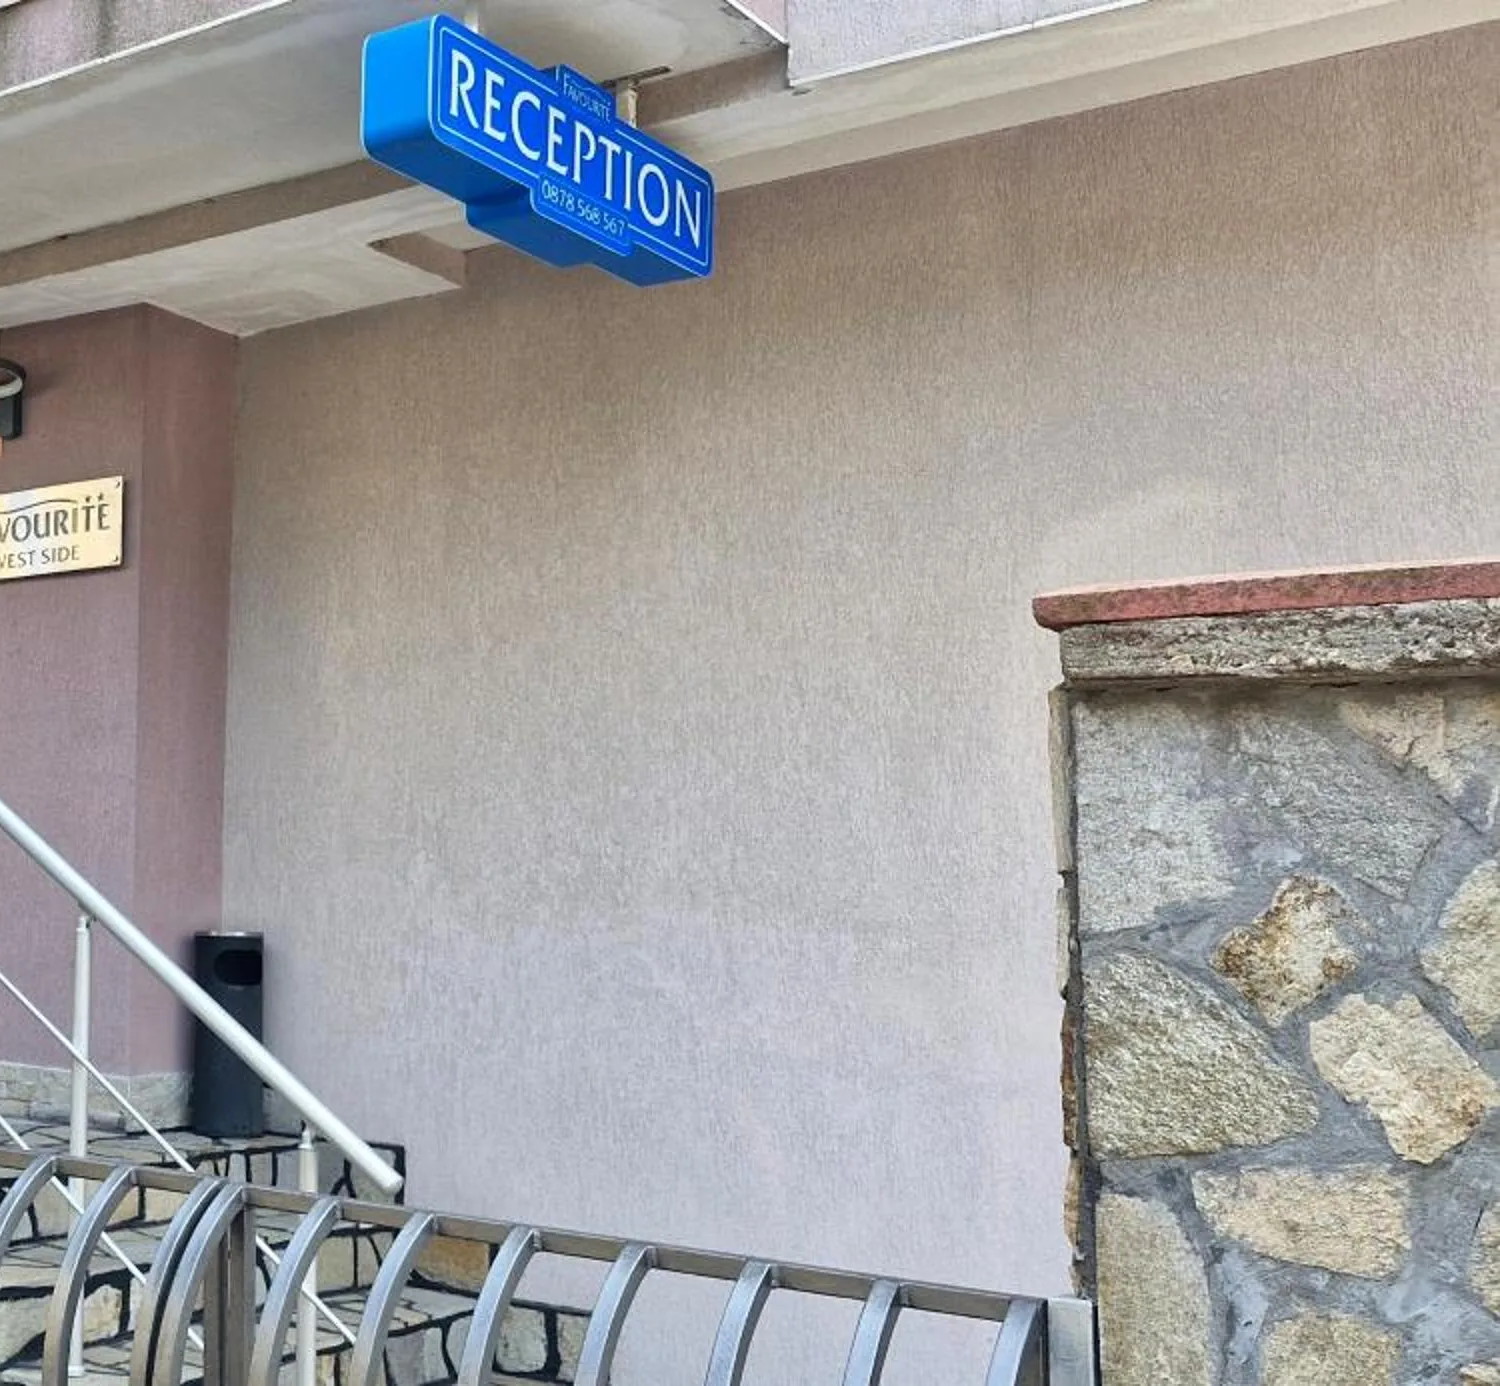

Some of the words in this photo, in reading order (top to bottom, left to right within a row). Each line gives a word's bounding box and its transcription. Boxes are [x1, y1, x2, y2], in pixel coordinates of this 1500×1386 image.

[451, 49, 702, 249] RECEPTION
[541, 179, 575, 213] 0878
[577, 198, 601, 225] 568
[603, 211, 625, 237] 567
[41, 545, 81, 568] SIDE
